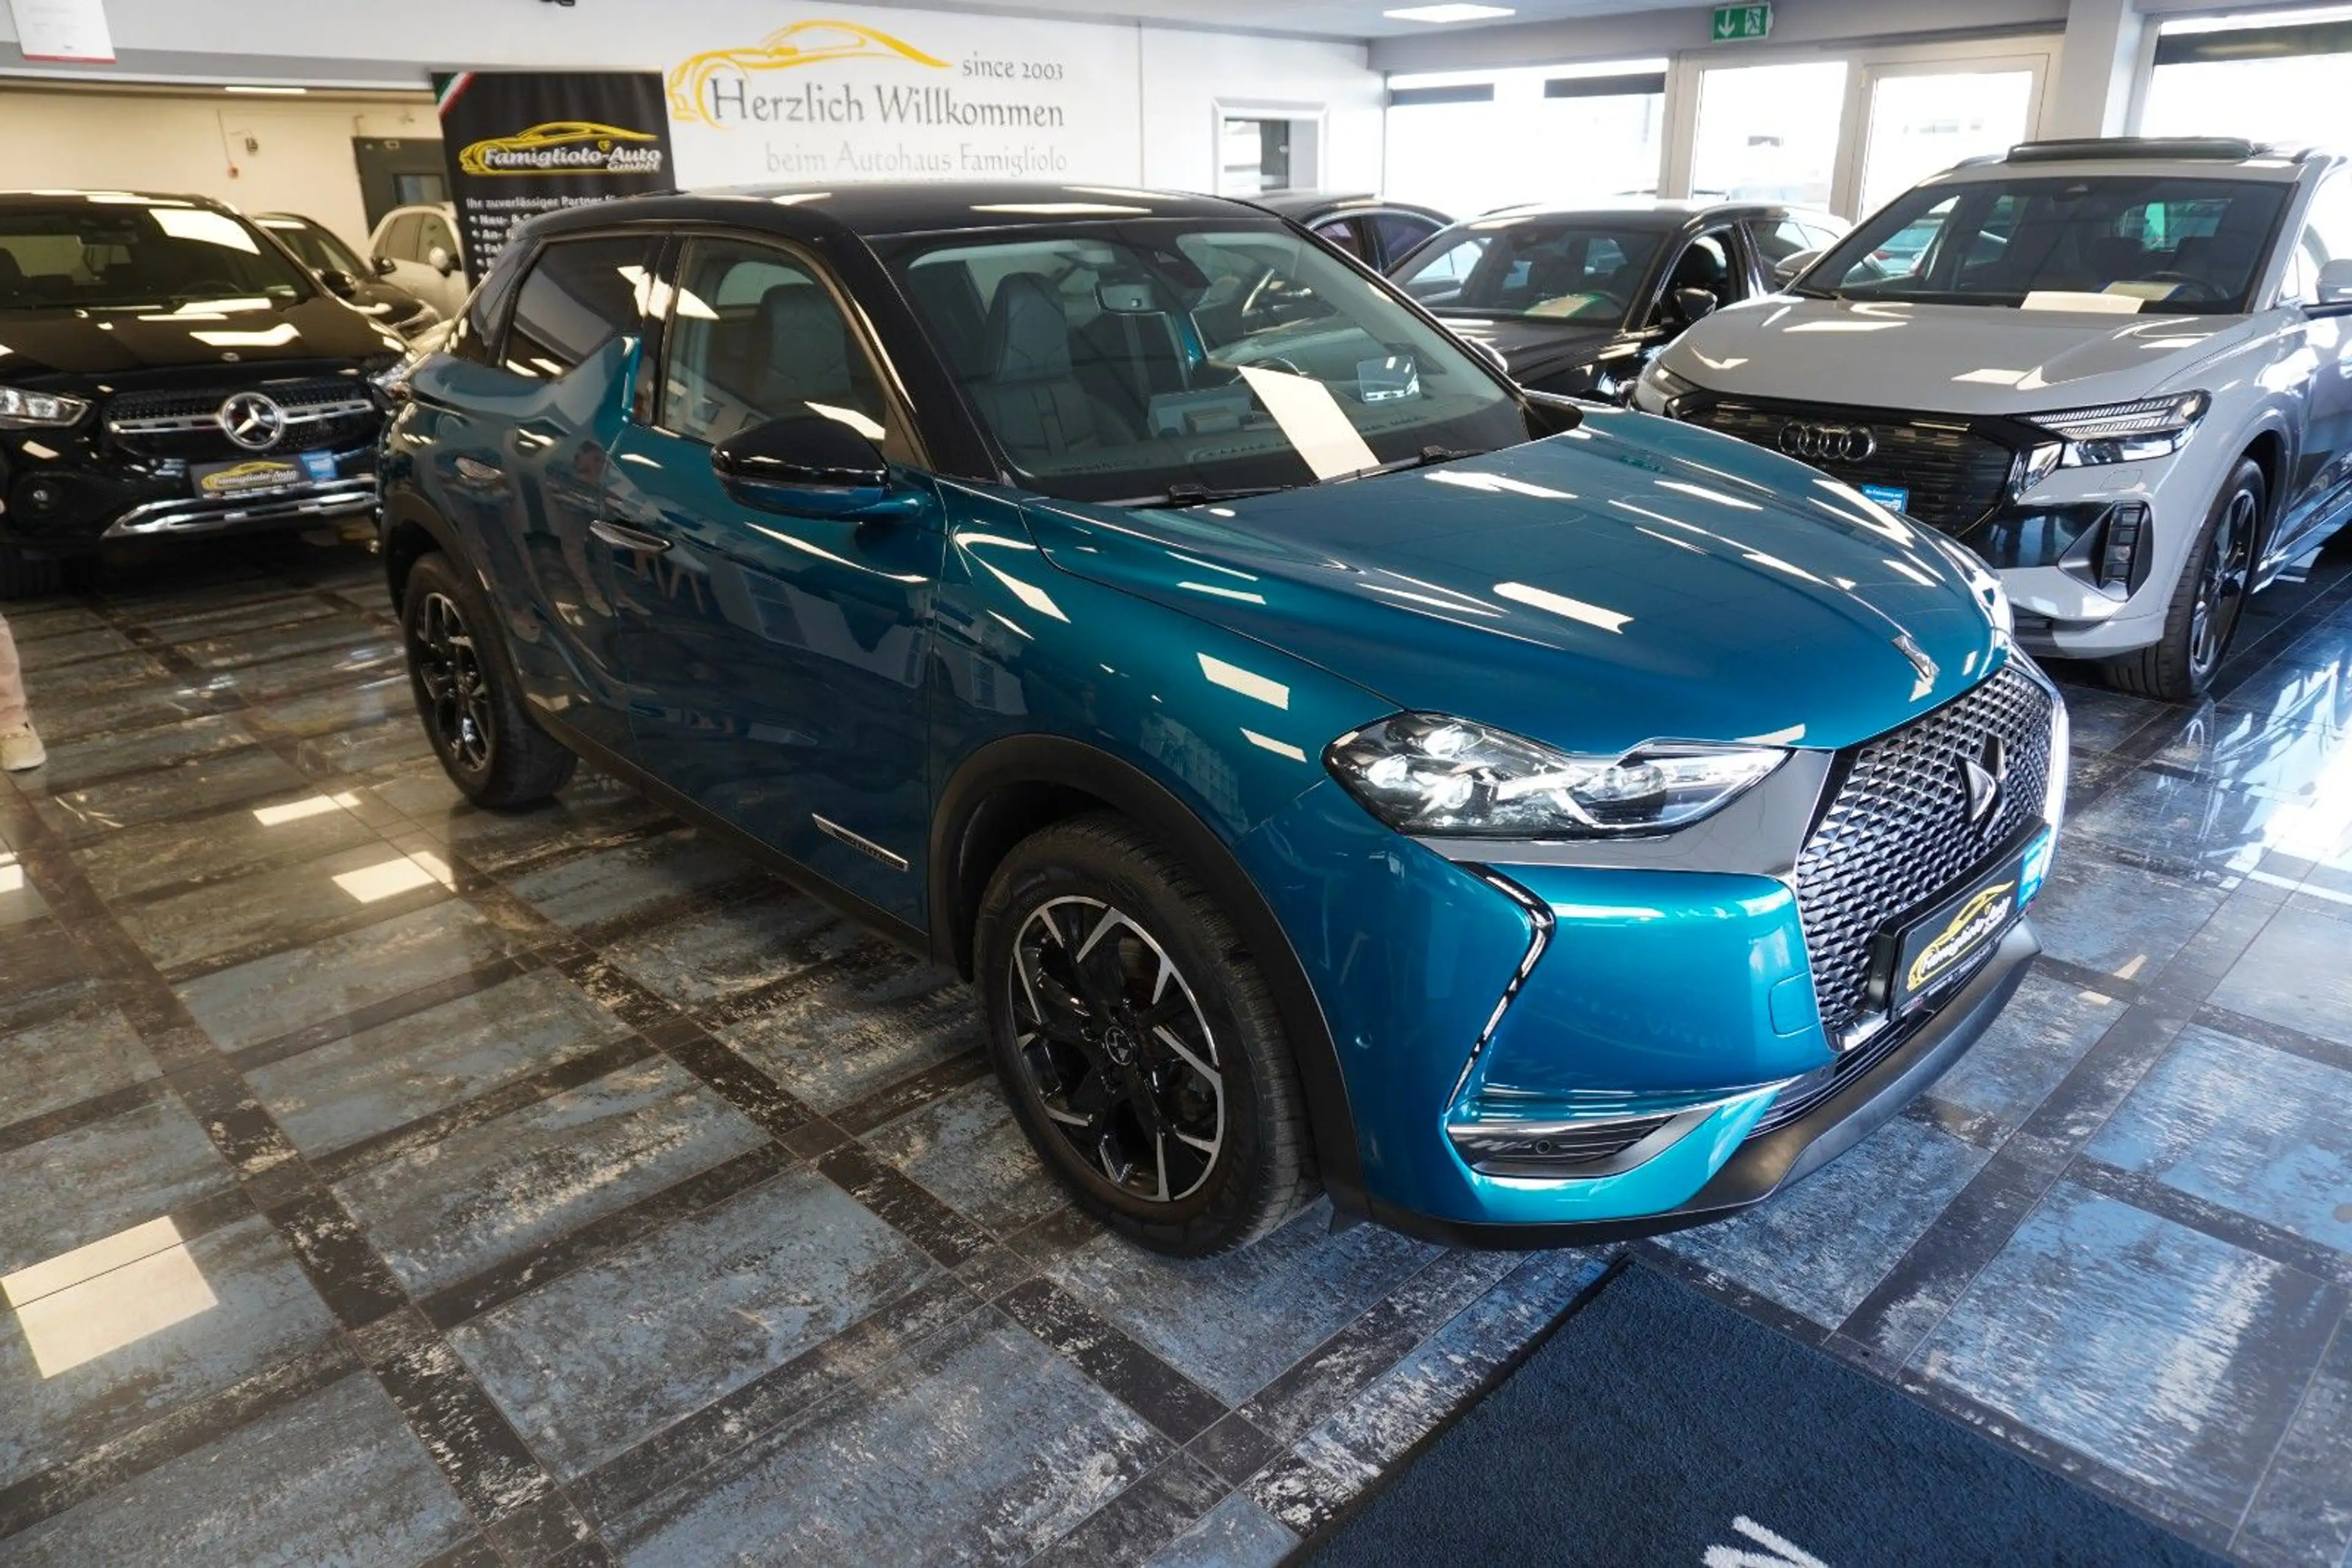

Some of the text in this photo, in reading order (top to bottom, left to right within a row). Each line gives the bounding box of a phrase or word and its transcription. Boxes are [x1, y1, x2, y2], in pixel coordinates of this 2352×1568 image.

[962, 51, 1065, 81] since 2003
[710, 78, 1065, 127] Herzlich Willkommen
[484, 146, 663, 168] Famigliolo-Auto
[765, 140, 1068, 177] beim Autohaus Famigliolo
[466, 197, 483, 209] Ihr
[486, 195, 559, 211] zuverlässiger
